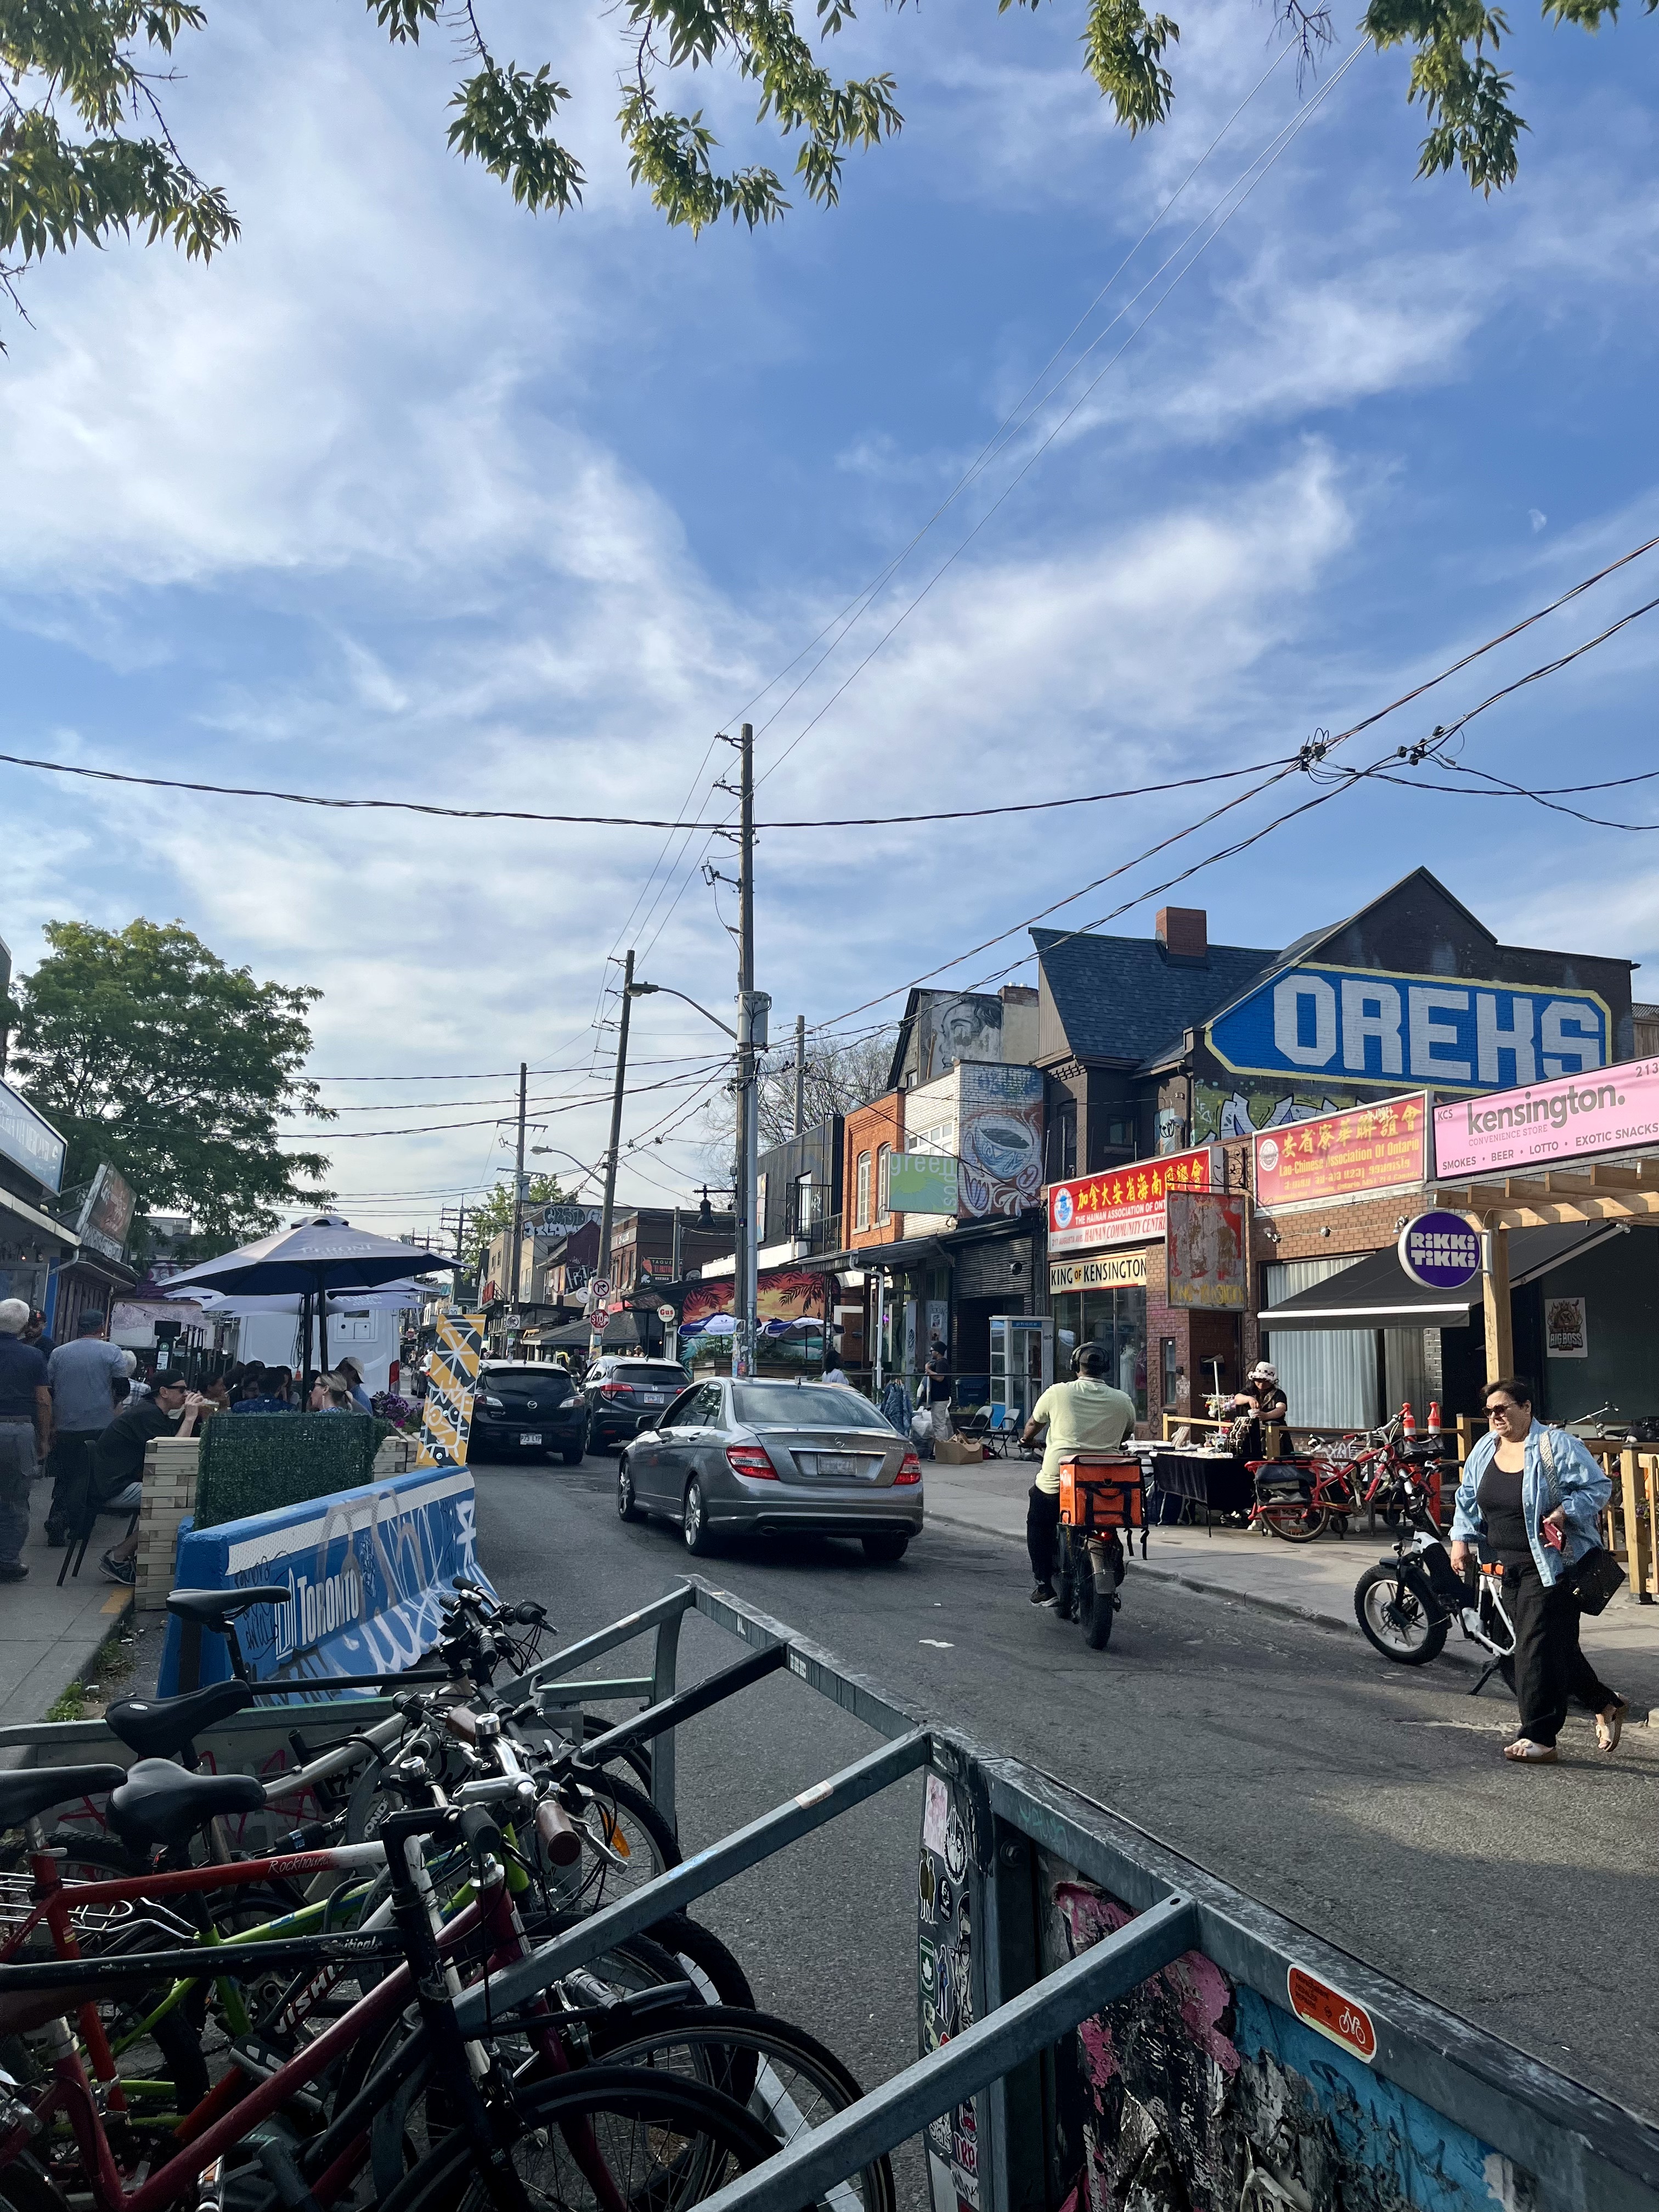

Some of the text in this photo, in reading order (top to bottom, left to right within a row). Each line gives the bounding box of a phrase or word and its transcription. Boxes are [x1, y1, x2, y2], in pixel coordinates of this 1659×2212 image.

[1635, 1062, 1658, 1077] 213
[1438, 1109, 1453, 1121] KCS
[1467, 1085, 1626, 1135] kensington.
[1469, 1125, 1547, 1146] CONVENIENCE STORE
[1443, 1122, 1658, 1170] SMOKES BEER LOTTO EXOTIC SNACKS
[1279, 1137, 1419, 1177] Lao-Chinese Association Of Ontario
[1338, 1181, 1360, 1190] Ontario
[1075, 1216, 1086, 1225] THE
[1086, 1213, 1107, 1223] HAINAN
[1107, 1205, 1144, 1220] ASSOCIATION
[1084, 1228, 1106, 1243] HAINAN
[1107, 1221, 1142, 1239] COMMUNITY
[1059, 1236, 1075, 1245] AUGUSTA
[301, 1244, 373, 1253] PERONI
[1051, 1257, 1146, 1286] KING OF KENSINGTON
[337, 1294, 382, 1302] PERONI
[591, 1314, 608, 1323] STOP
[1550, 1332, 1582, 1346] BIG BOSS
